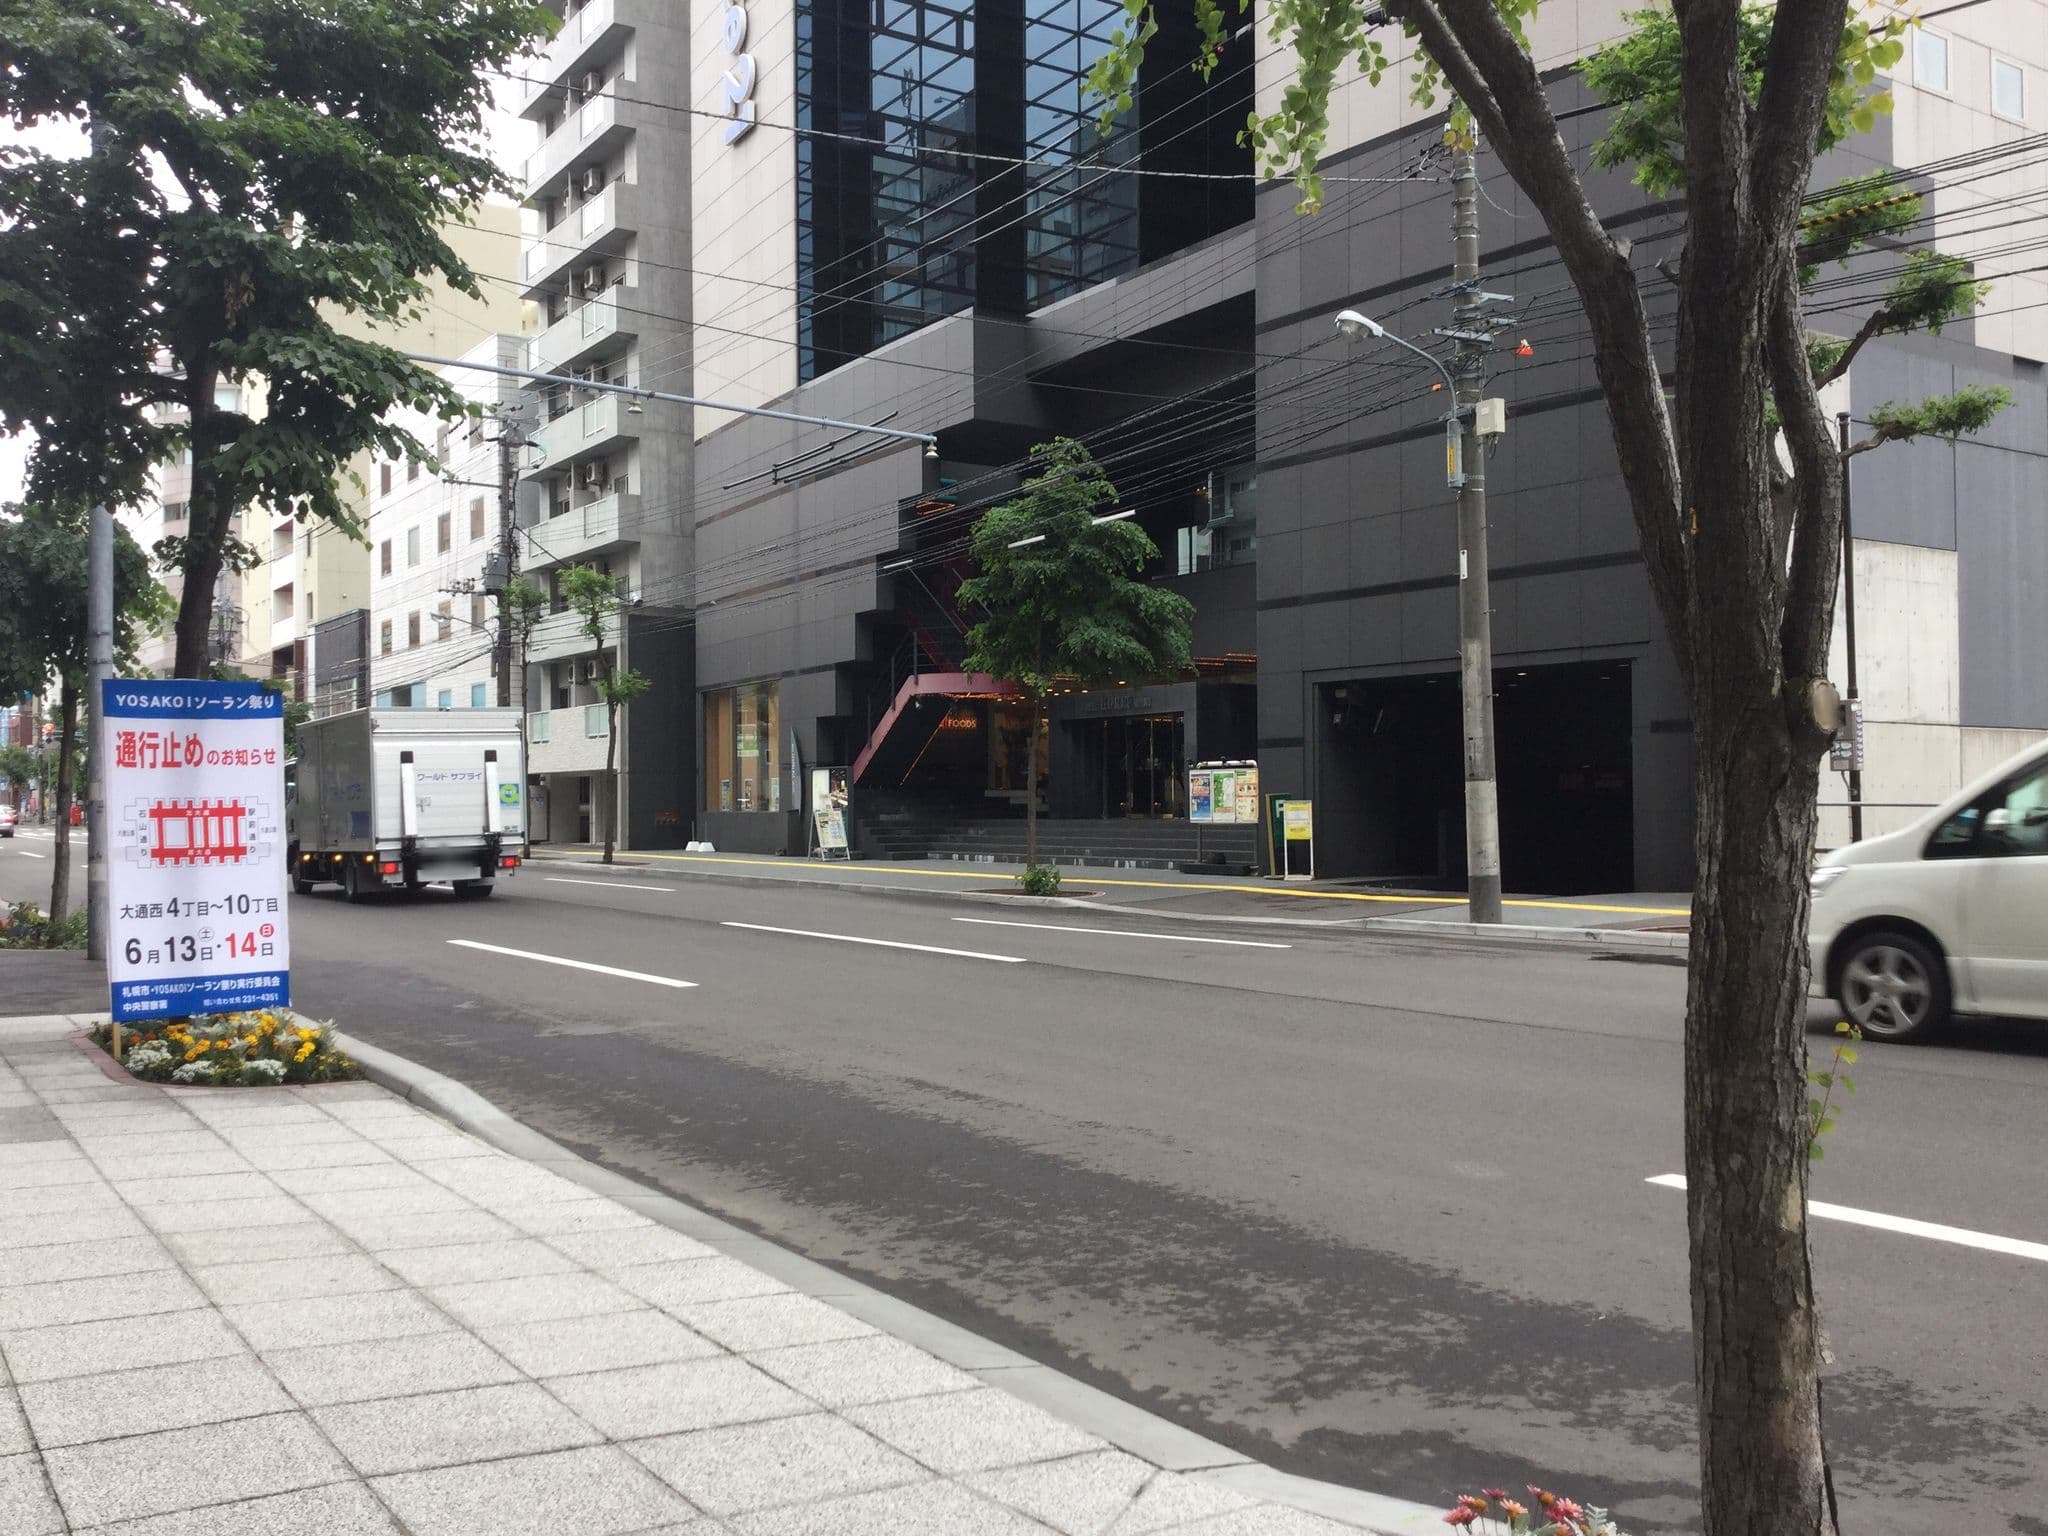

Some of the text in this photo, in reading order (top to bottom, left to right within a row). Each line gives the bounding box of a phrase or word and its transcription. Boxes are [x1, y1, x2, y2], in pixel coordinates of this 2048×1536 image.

[115, 694, 275, 709] YOSAKOIソーラン祭り
[115, 730, 276, 769] 通行止めのお知らせ
